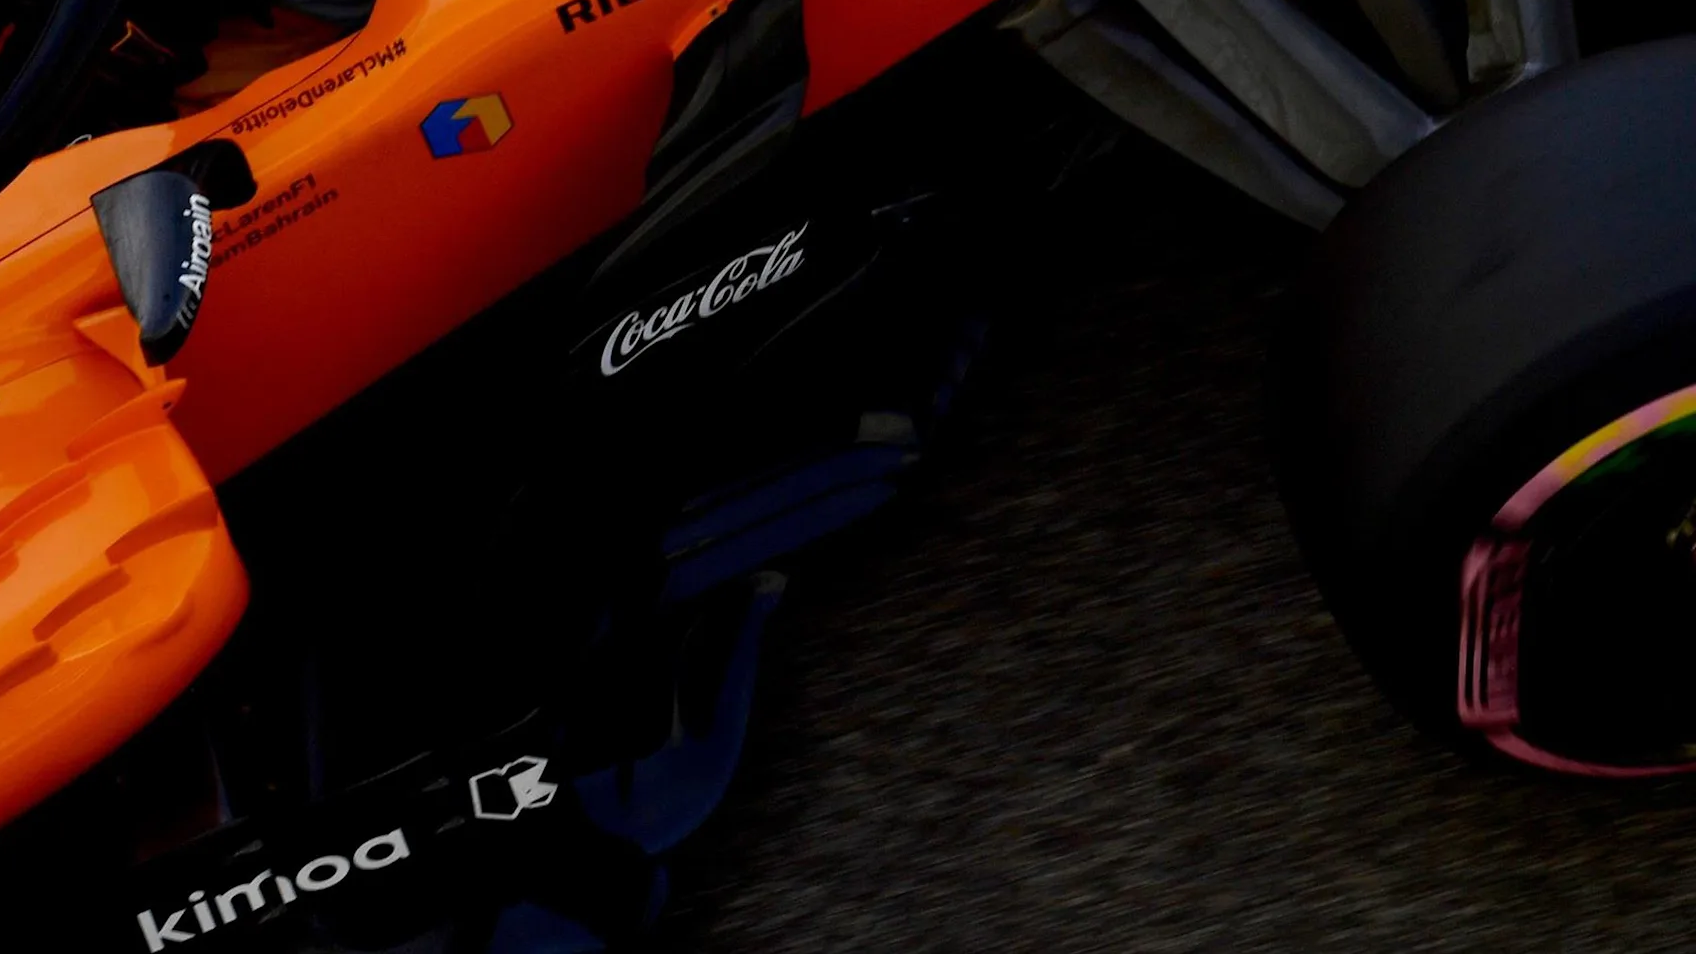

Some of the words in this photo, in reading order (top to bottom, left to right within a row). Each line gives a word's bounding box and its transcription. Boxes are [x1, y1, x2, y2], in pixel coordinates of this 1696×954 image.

[231, 38, 406, 135] #McLarenDeloitte
[211, 172, 316, 243] cLarenF1
[600, 219, 809, 377] Coca-Cola
[136, 827, 411, 954] kimoa
